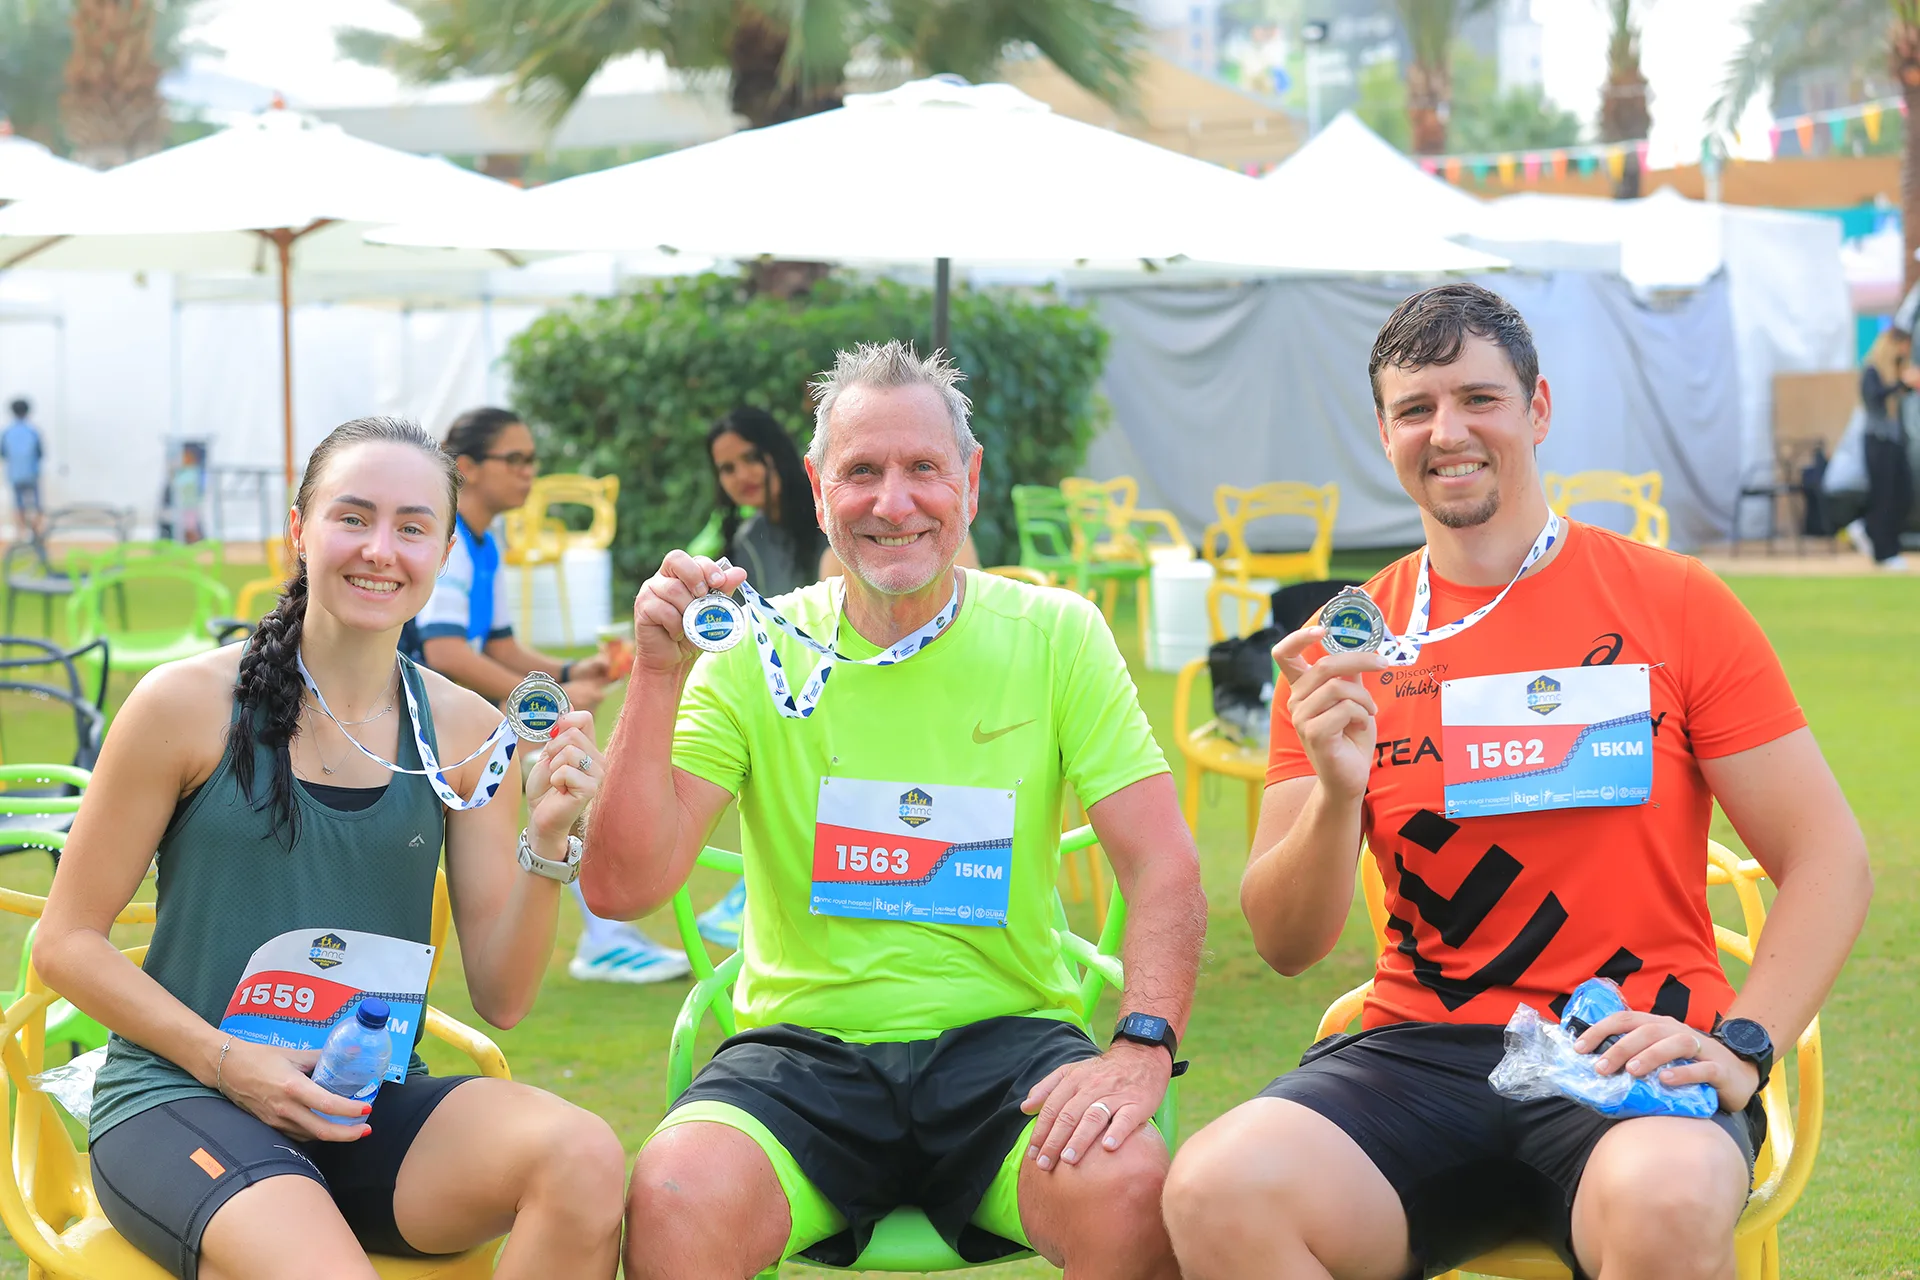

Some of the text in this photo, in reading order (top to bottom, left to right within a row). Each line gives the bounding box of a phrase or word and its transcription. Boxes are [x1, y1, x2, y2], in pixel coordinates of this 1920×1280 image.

[1395, 664, 1449, 680] Discovery
[1395, 679, 1440, 700] Vitality
[1539, 693, 1561, 703] nmc
[1375, 735, 1443, 768] TEA
[1466, 738, 1545, 770] 1562
[1591, 741, 1644, 757] 15KM
[1484, 796, 1510, 804] hospital
[1514, 793, 1539, 804] Ripe
[910, 807, 932, 816] nmc
[835, 844, 910, 875] 1563
[954, 862, 1003, 880] 15KM
[847, 899, 872, 907] hospital
[875, 901, 900, 913] Ripe
[321, 950, 345, 960] nmc
[239, 983, 315, 1013] 1559
[227, 1027, 244, 1035] royal
[244, 1030, 269, 1041] hospital
[272, 1035, 297, 1049] Ripe
[388, 1065, 405, 1074] UBAI
